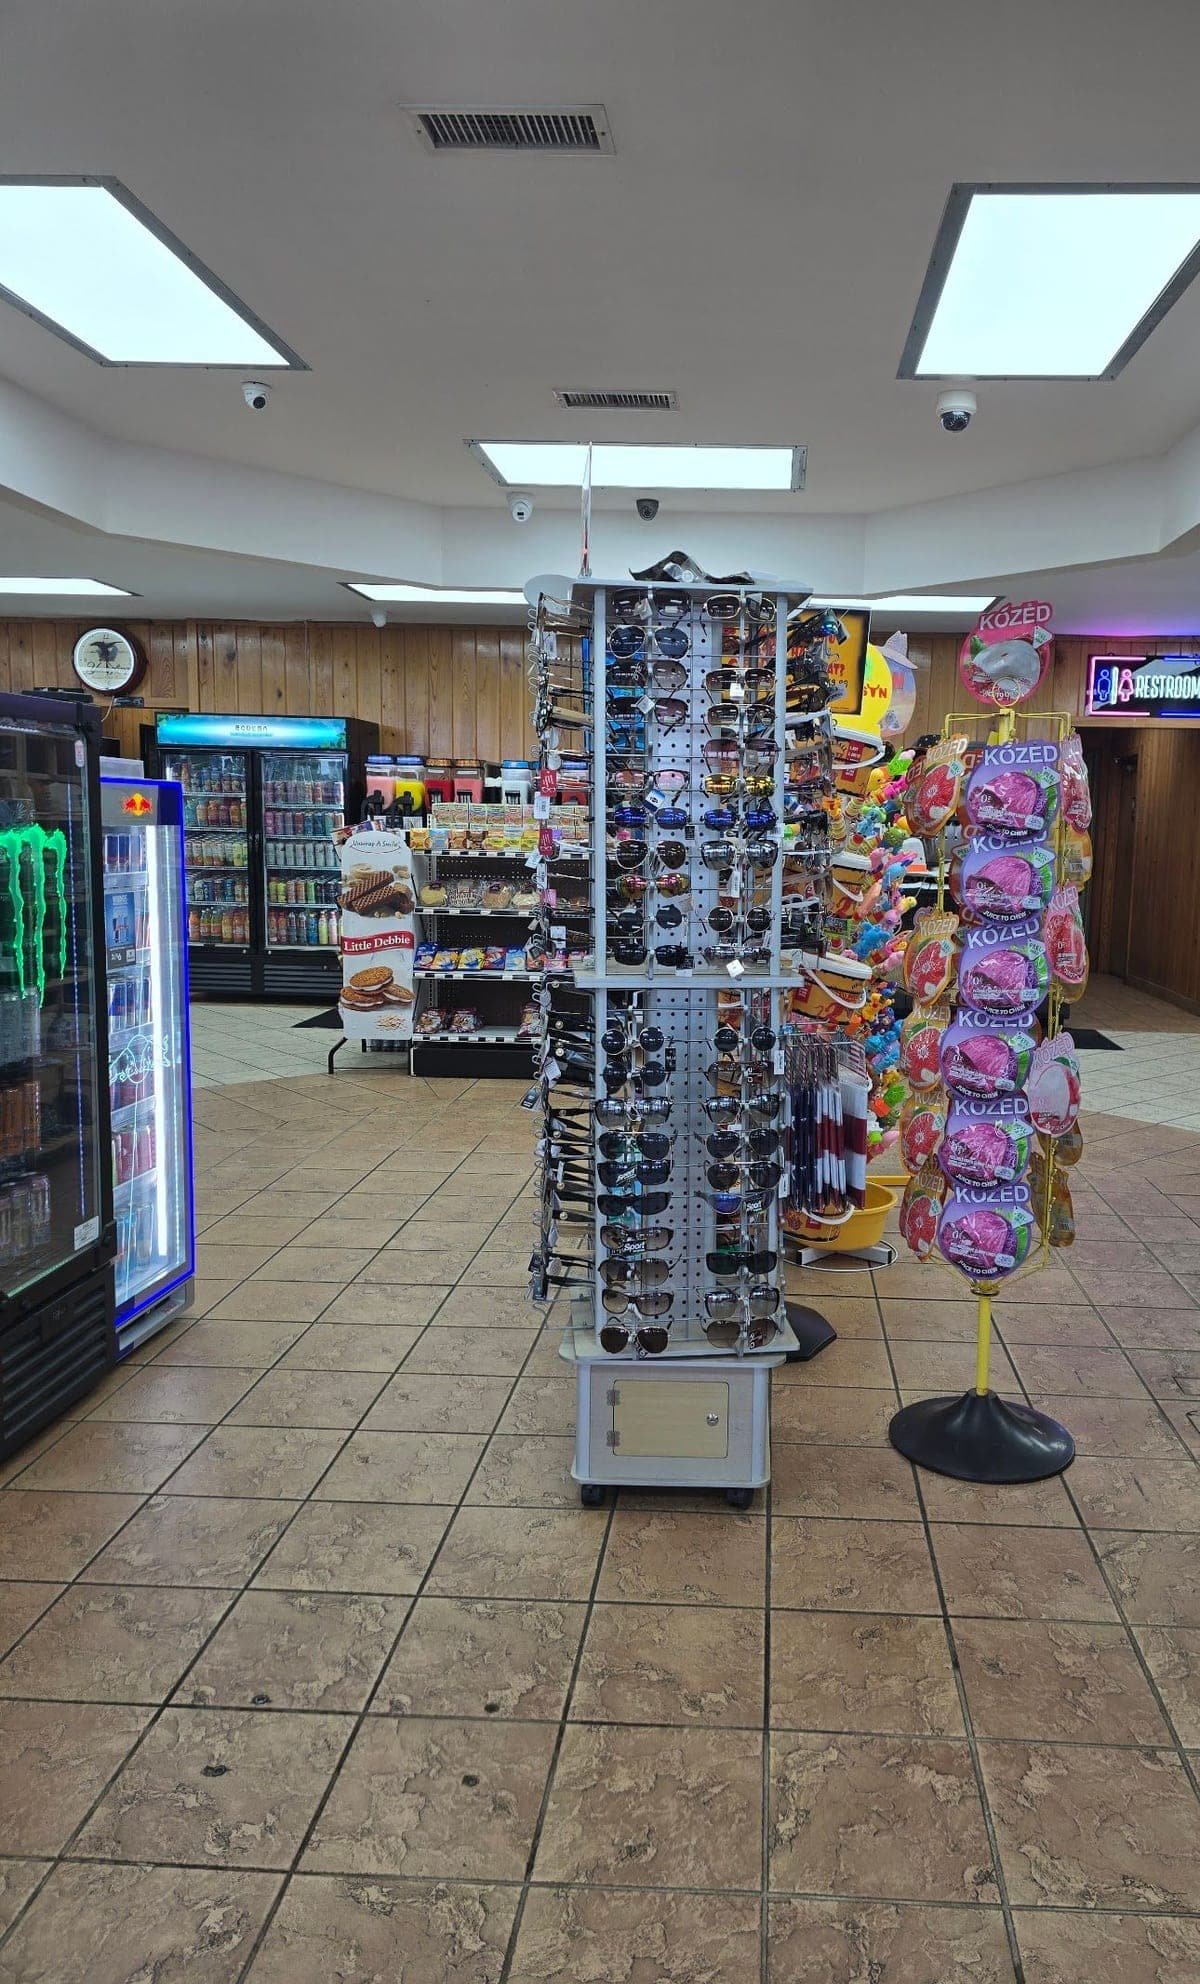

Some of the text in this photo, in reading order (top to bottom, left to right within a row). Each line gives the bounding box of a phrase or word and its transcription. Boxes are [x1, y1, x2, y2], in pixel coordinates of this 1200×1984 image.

[344, 934, 411, 952] Little Debbie
[624, 1241, 645, 1252] Sport
